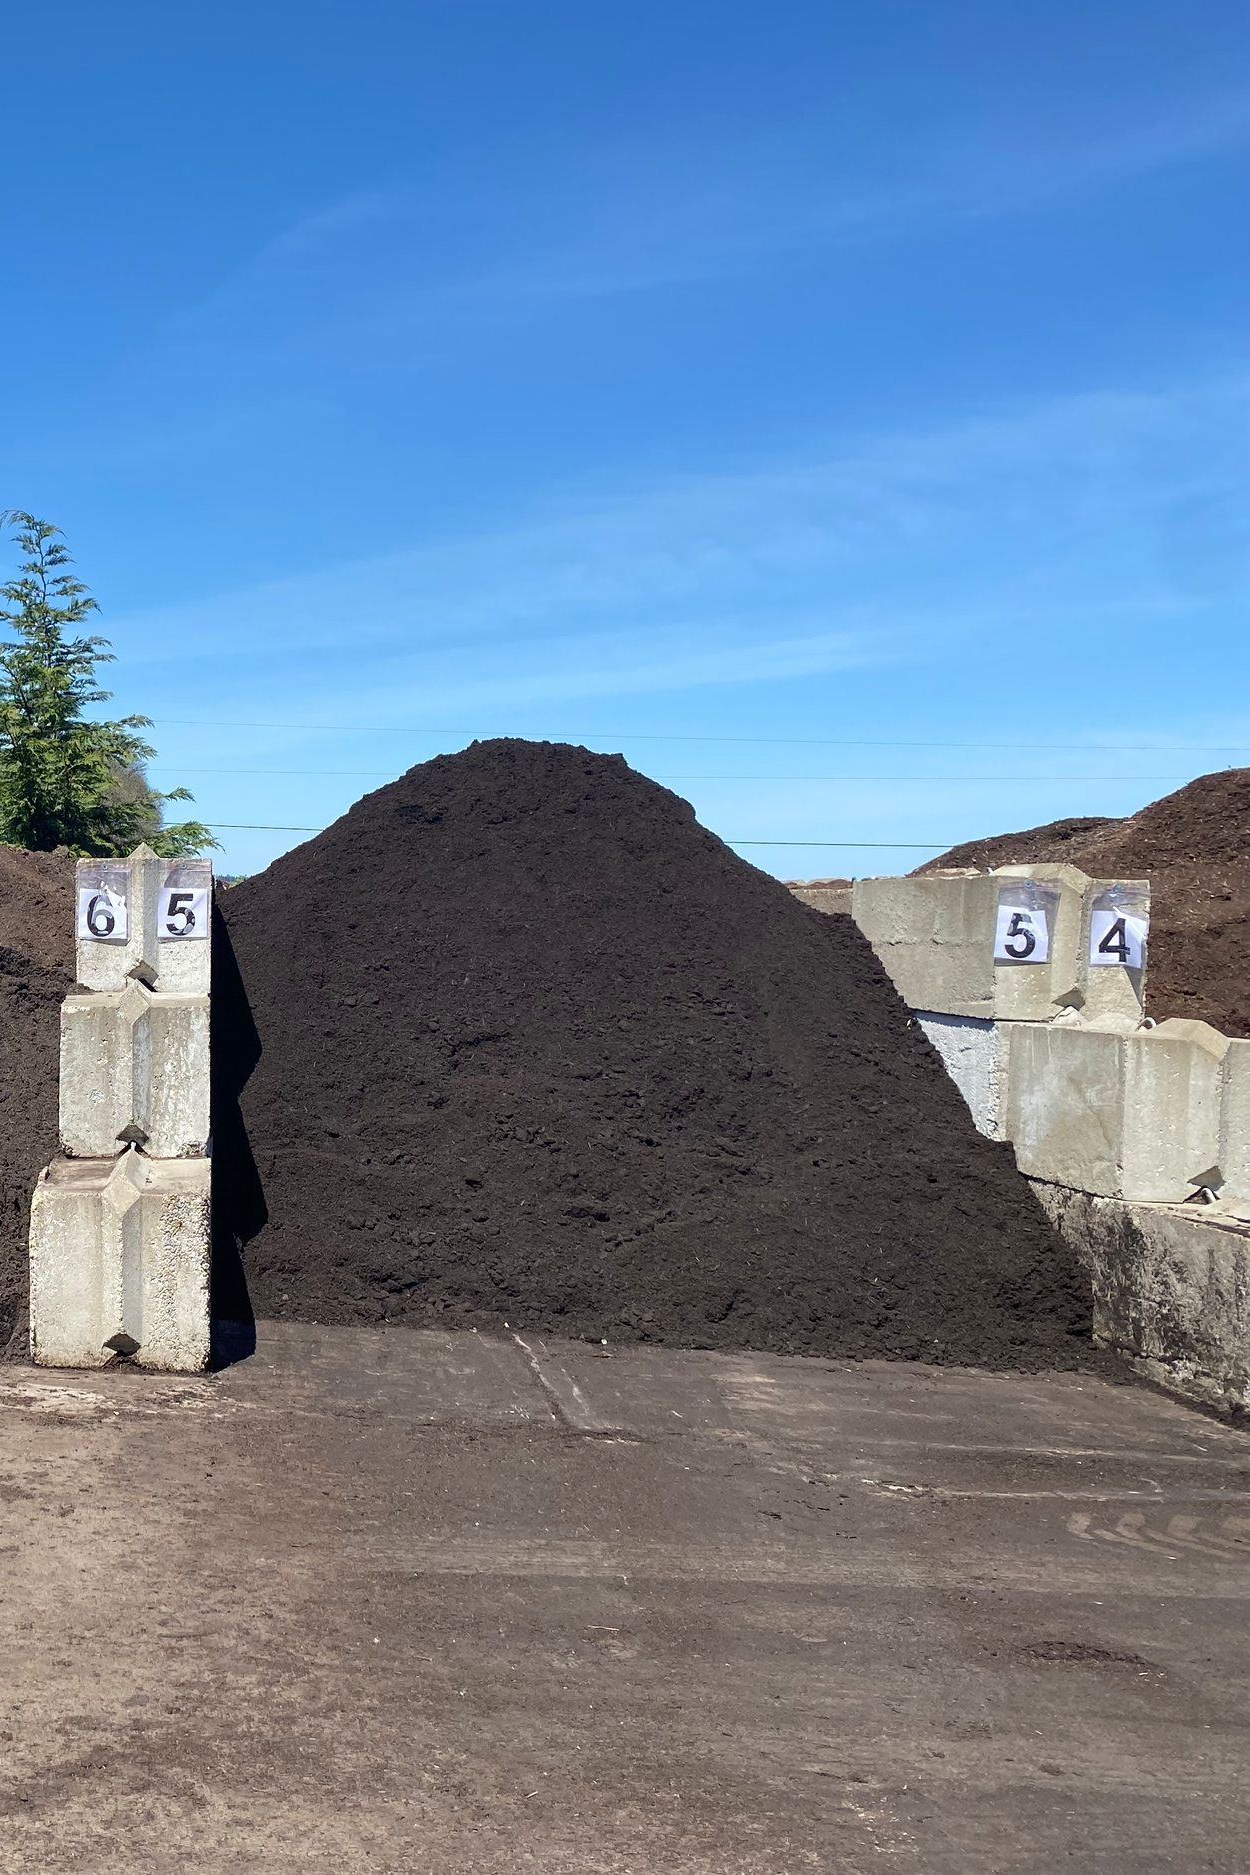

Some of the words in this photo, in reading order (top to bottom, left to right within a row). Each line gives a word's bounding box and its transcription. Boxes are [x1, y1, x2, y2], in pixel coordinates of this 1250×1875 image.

[86, 894, 116, 938] 6
[165, 893, 196, 936] 5
[1004, 912, 1036, 959] 5
[1098, 917, 1131, 962] 4
